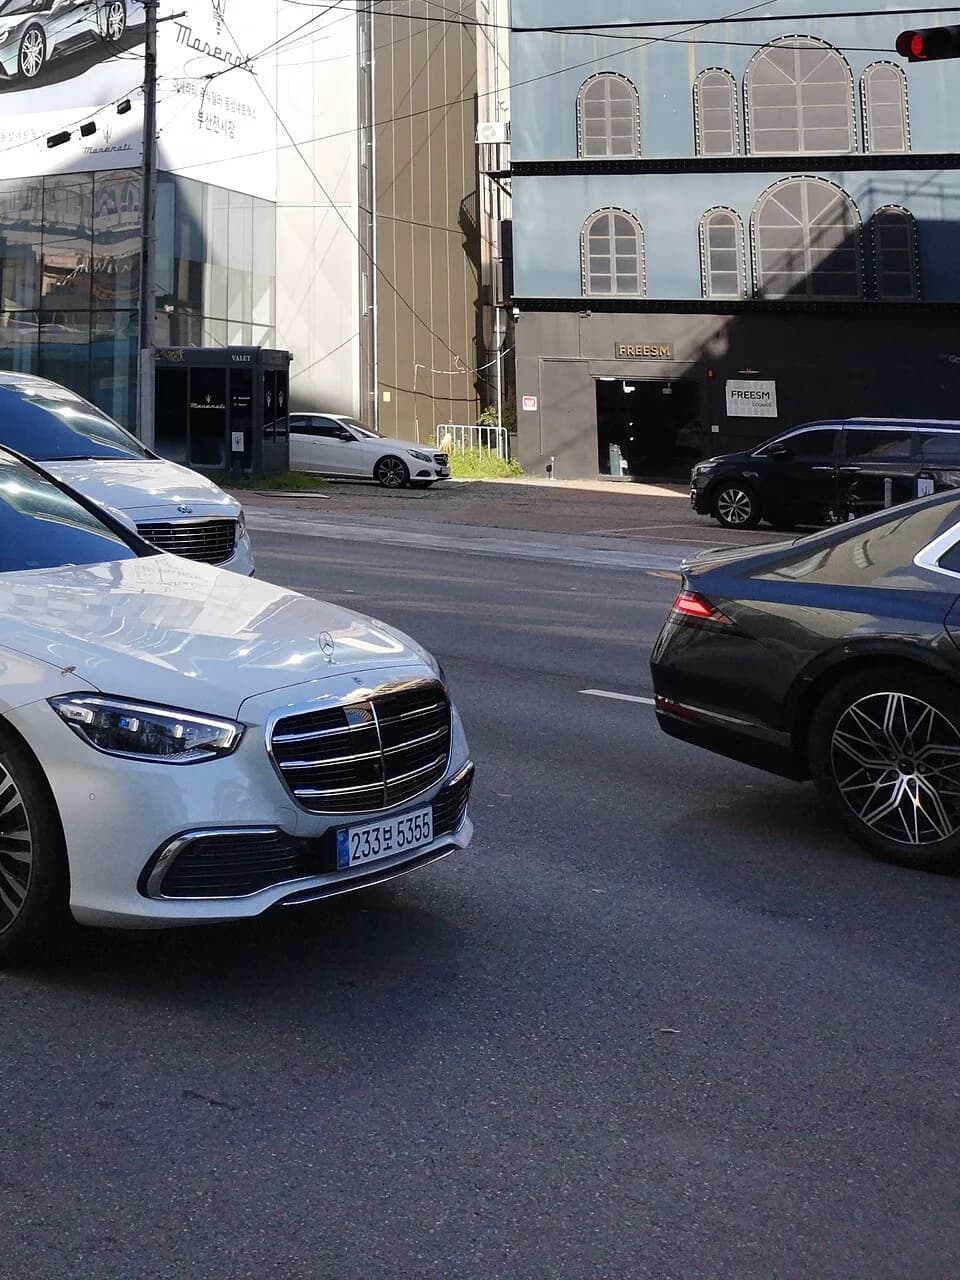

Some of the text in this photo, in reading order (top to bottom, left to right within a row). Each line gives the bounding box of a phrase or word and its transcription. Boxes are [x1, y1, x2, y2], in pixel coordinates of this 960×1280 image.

[619, 344, 670, 357] FREESM
[231, 354, 251, 362] VALET
[731, 390, 770, 400] FREESM
[351, 812, 430, 861] 233보 5355
